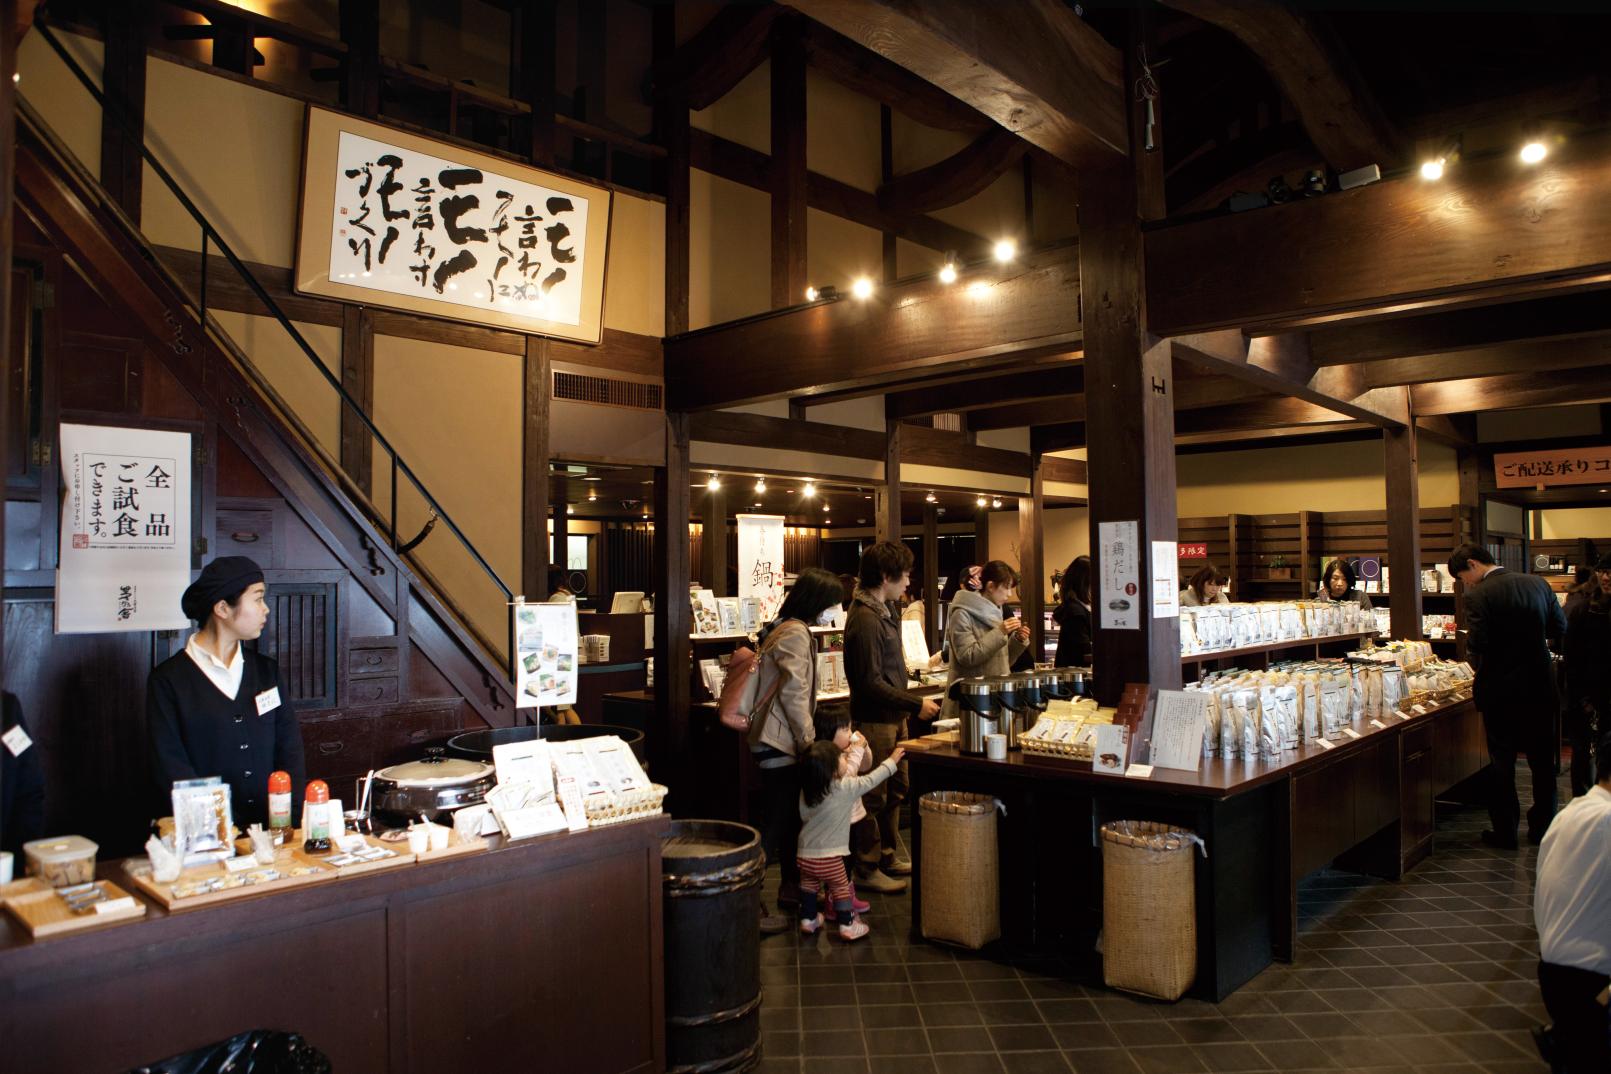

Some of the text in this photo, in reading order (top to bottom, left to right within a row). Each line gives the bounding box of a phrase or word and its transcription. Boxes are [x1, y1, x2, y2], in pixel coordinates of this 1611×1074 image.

[88, 461, 107, 538] できます。
[112, 461, 140, 538] ご試食
[144, 464, 171, 537] 全品
[752, 559, 774, 589] 鍋
